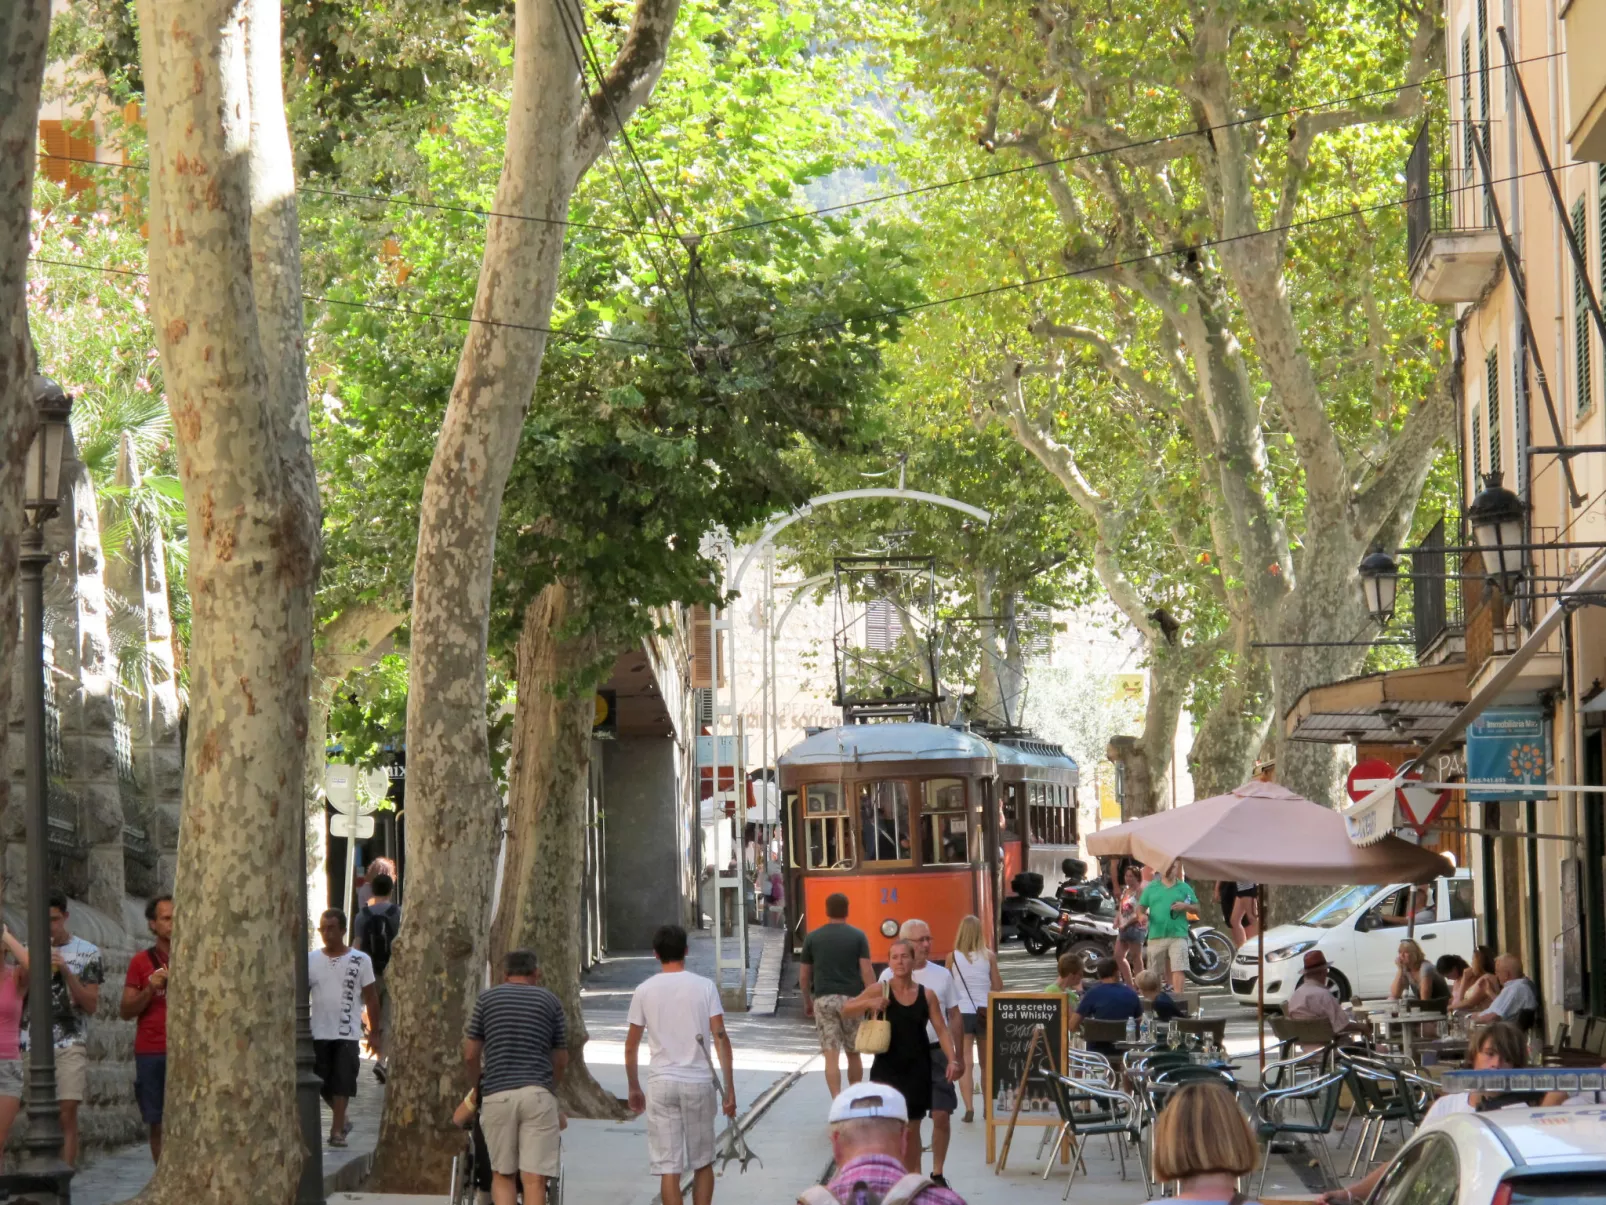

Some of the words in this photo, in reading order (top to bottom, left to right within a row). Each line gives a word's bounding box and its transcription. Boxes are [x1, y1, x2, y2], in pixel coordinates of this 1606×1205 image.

[880, 887, 899, 905] 24
[339, 955, 362, 1037] CLUBBER
[998, 1003, 1013, 1011] Los
[1016, 1003, 1057, 1011] secretos
[1001, 1011, 1017, 1019] del
[1020, 1011, 1053, 1021] Whisky
